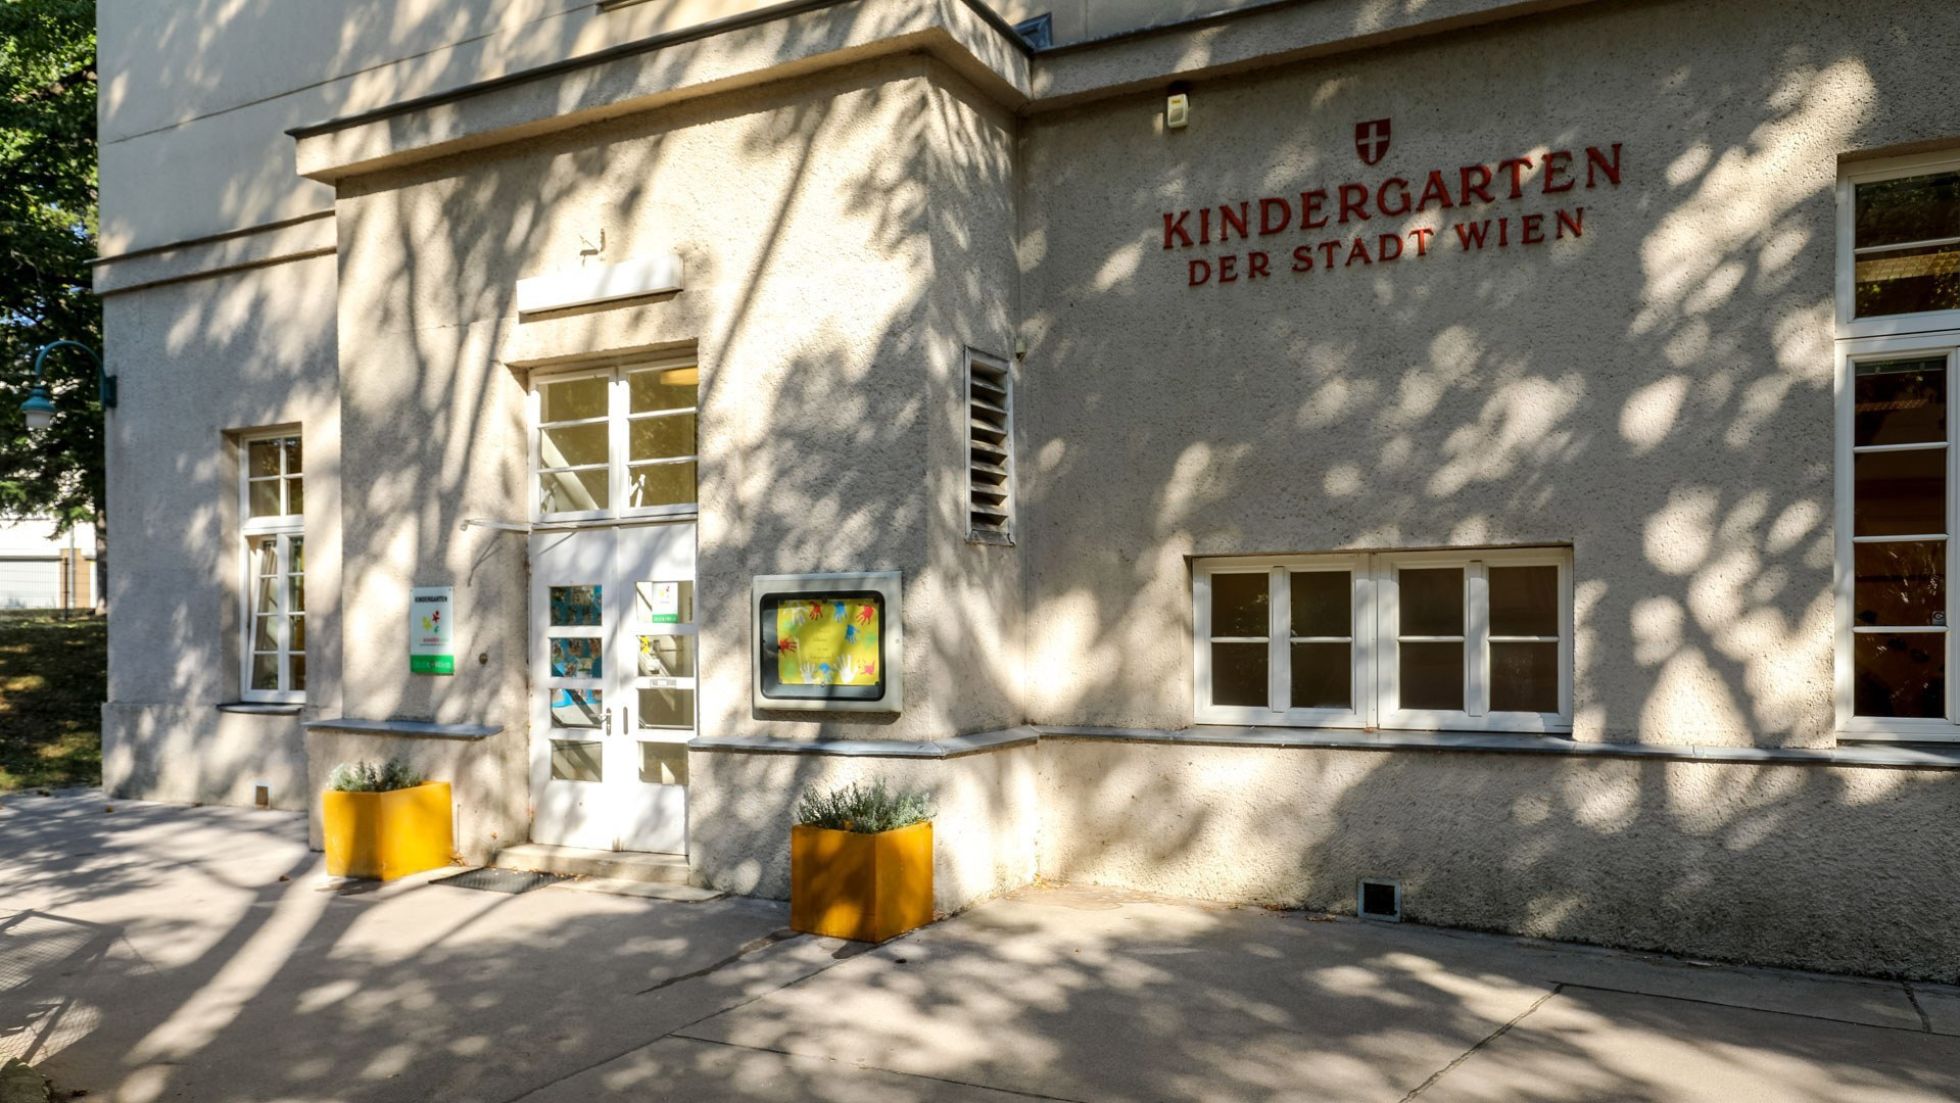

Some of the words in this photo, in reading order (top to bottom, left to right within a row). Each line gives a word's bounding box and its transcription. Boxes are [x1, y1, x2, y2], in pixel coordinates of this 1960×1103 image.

[1162, 143, 1623, 250] KINDERGARTEN
[1188, 251, 1271, 287] DER
[1291, 228, 1435, 273] STADT
[1454, 207, 1585, 251] WIEN
